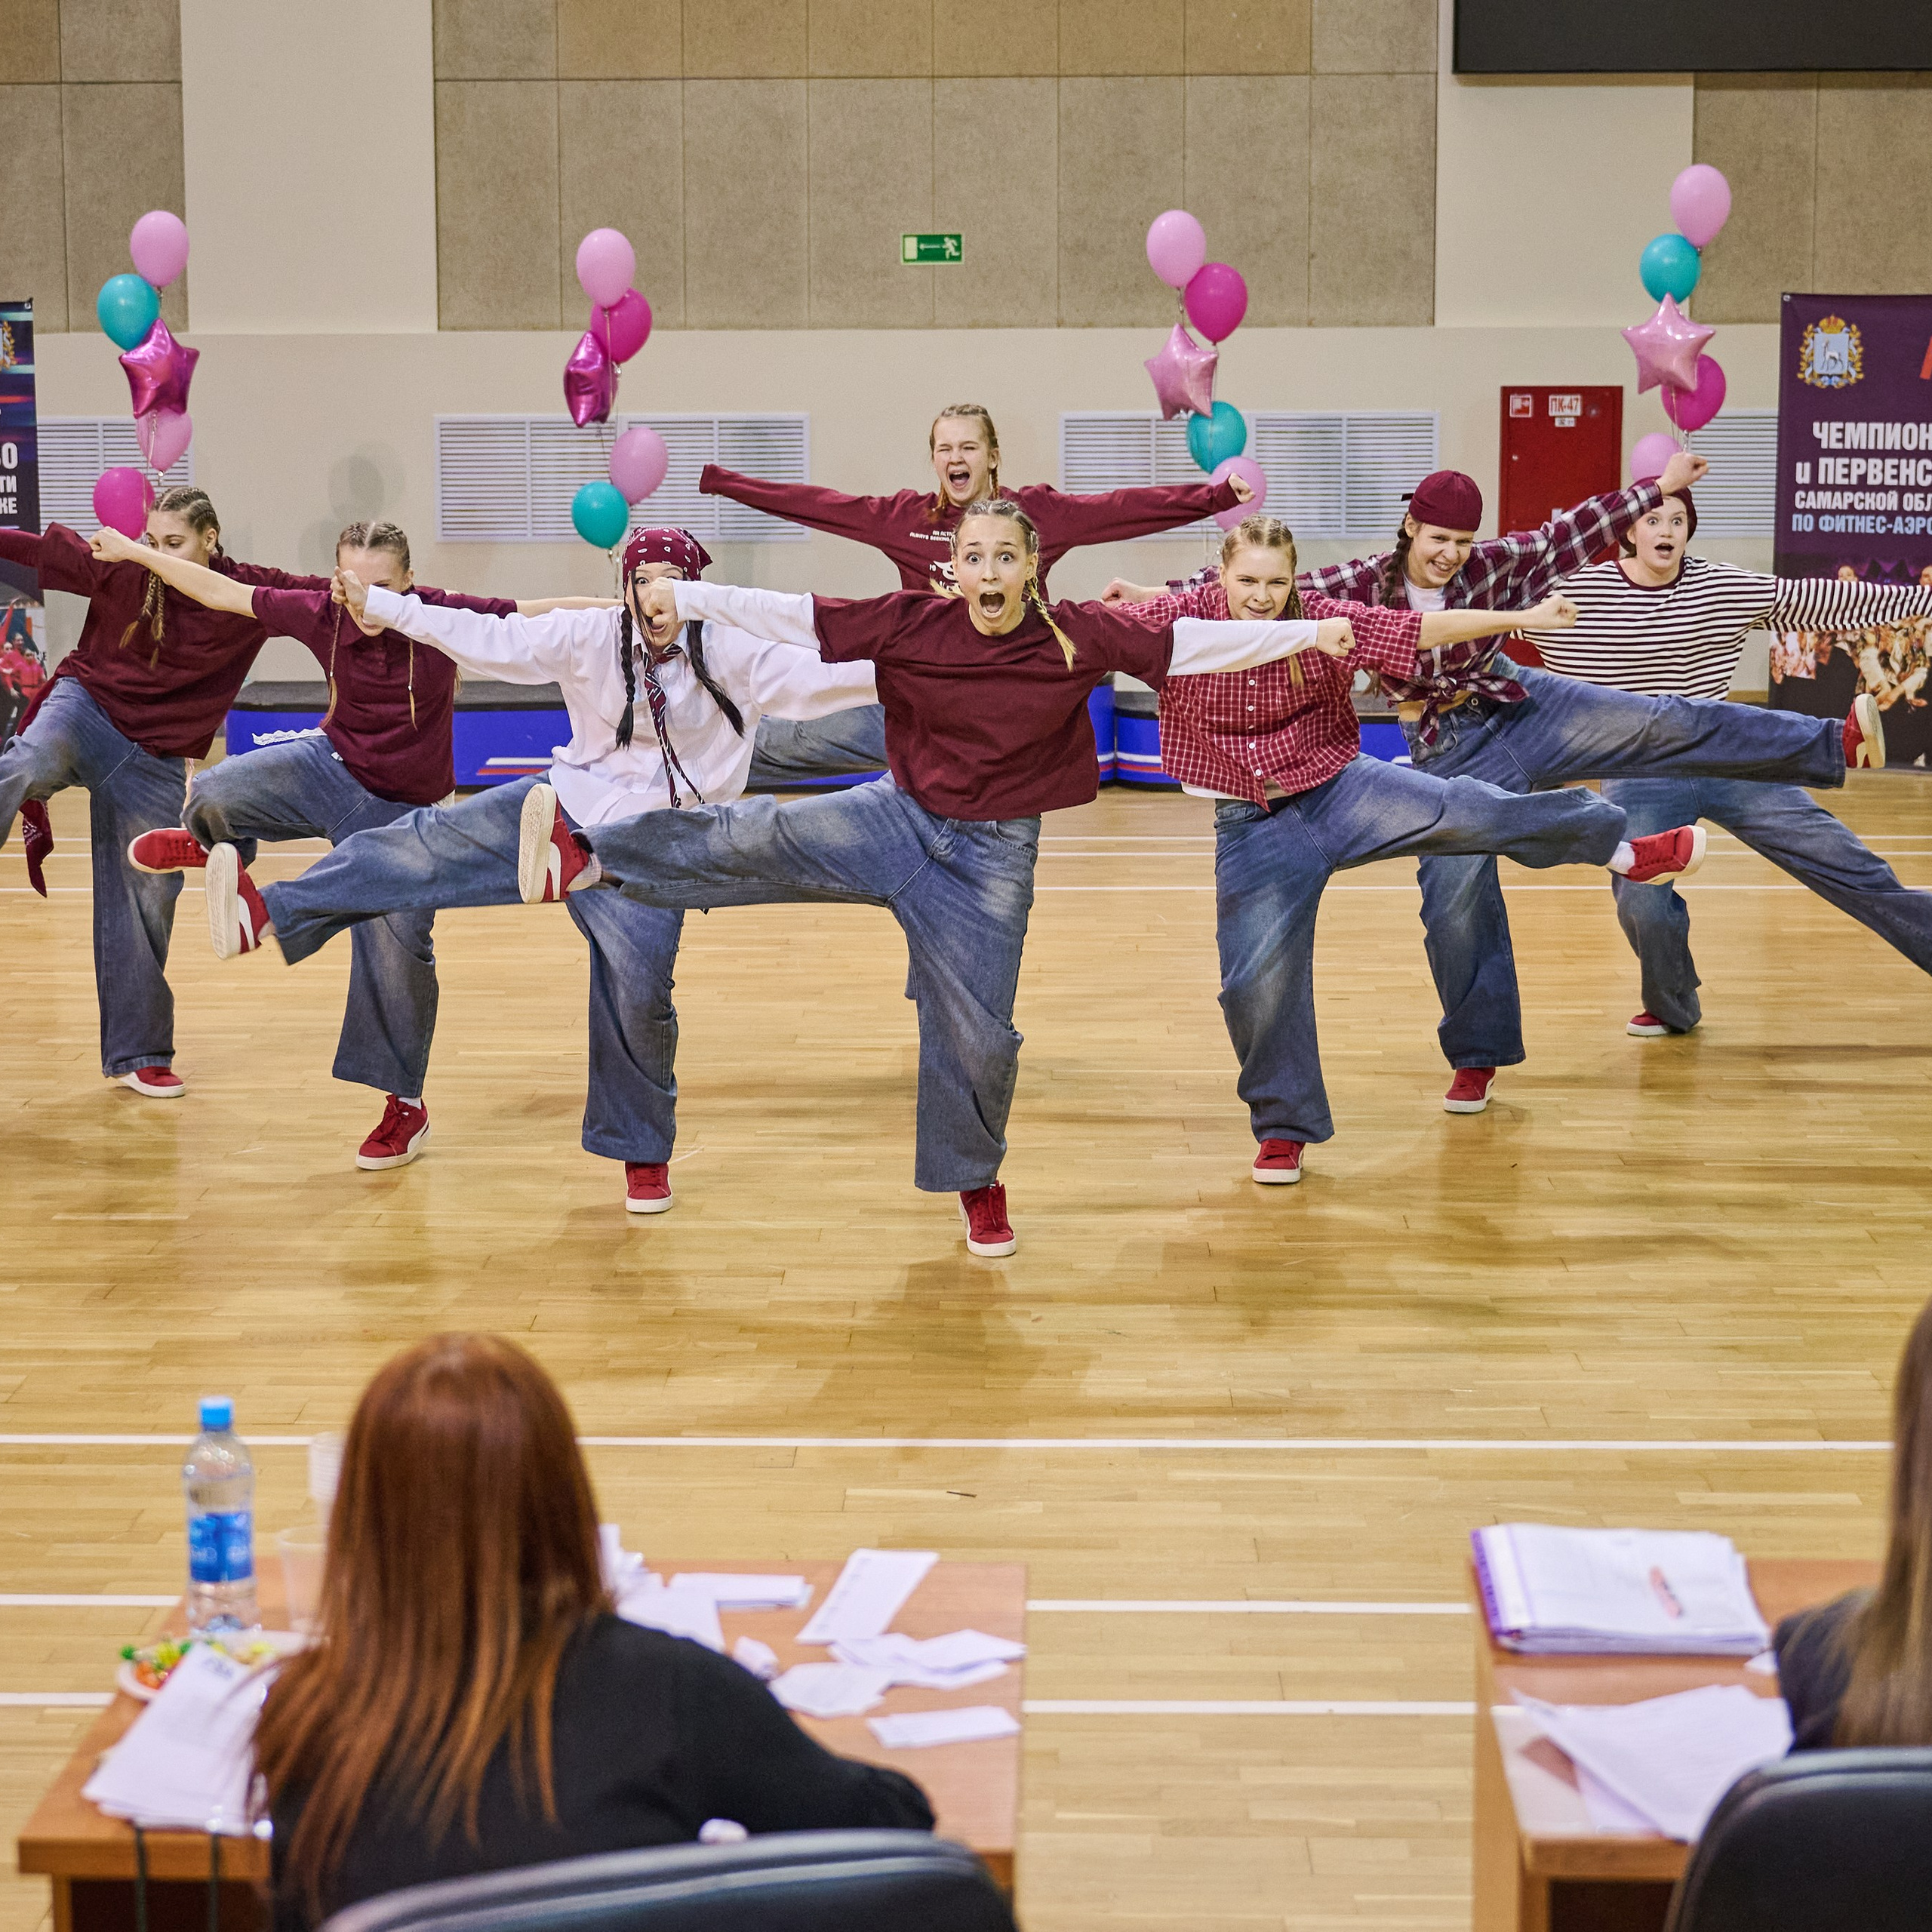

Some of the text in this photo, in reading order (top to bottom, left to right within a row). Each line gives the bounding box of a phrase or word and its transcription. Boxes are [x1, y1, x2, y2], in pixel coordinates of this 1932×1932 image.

[1550, 397, 1579, 412] ПК-47
[1813, 421, 1932, 451] ЧЕМПИОН
[1795, 457, 1932, 487] и ПЕРВЕНС
[1795, 491, 1899, 511] САМАРСКОЙ
[1792, 513, 1814, 532] ПО
